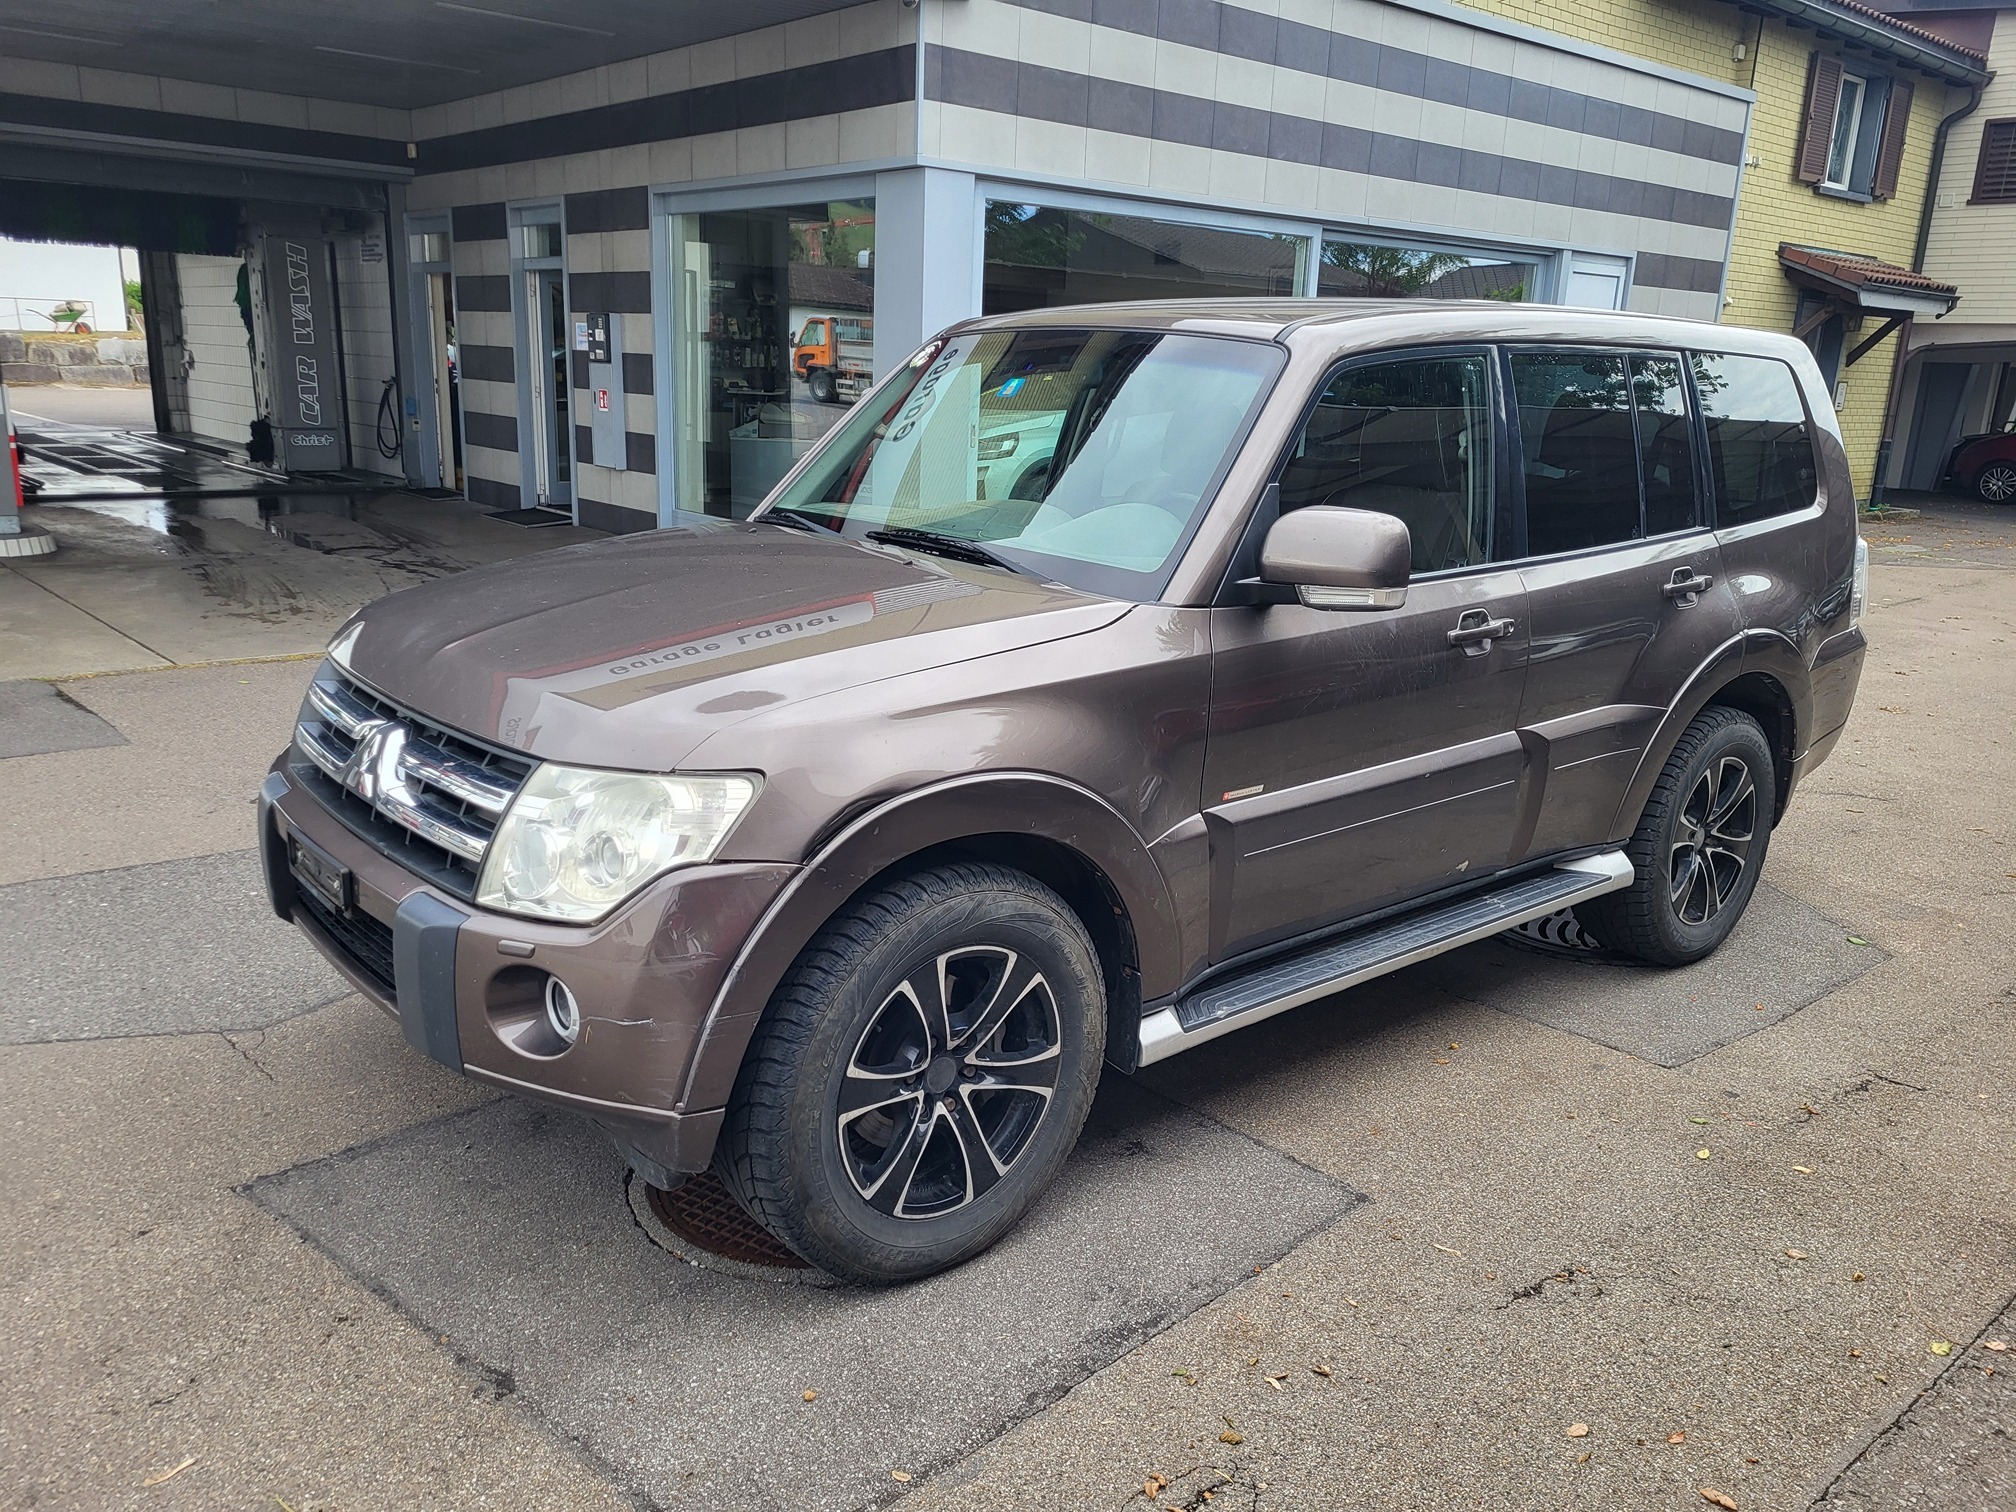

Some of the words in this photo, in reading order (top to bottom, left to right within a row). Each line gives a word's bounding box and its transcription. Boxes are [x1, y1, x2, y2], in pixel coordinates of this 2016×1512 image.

[285, 241, 315, 345] WASH
[295, 355, 322, 426] CAR
[290, 434, 334, 446] Christ
